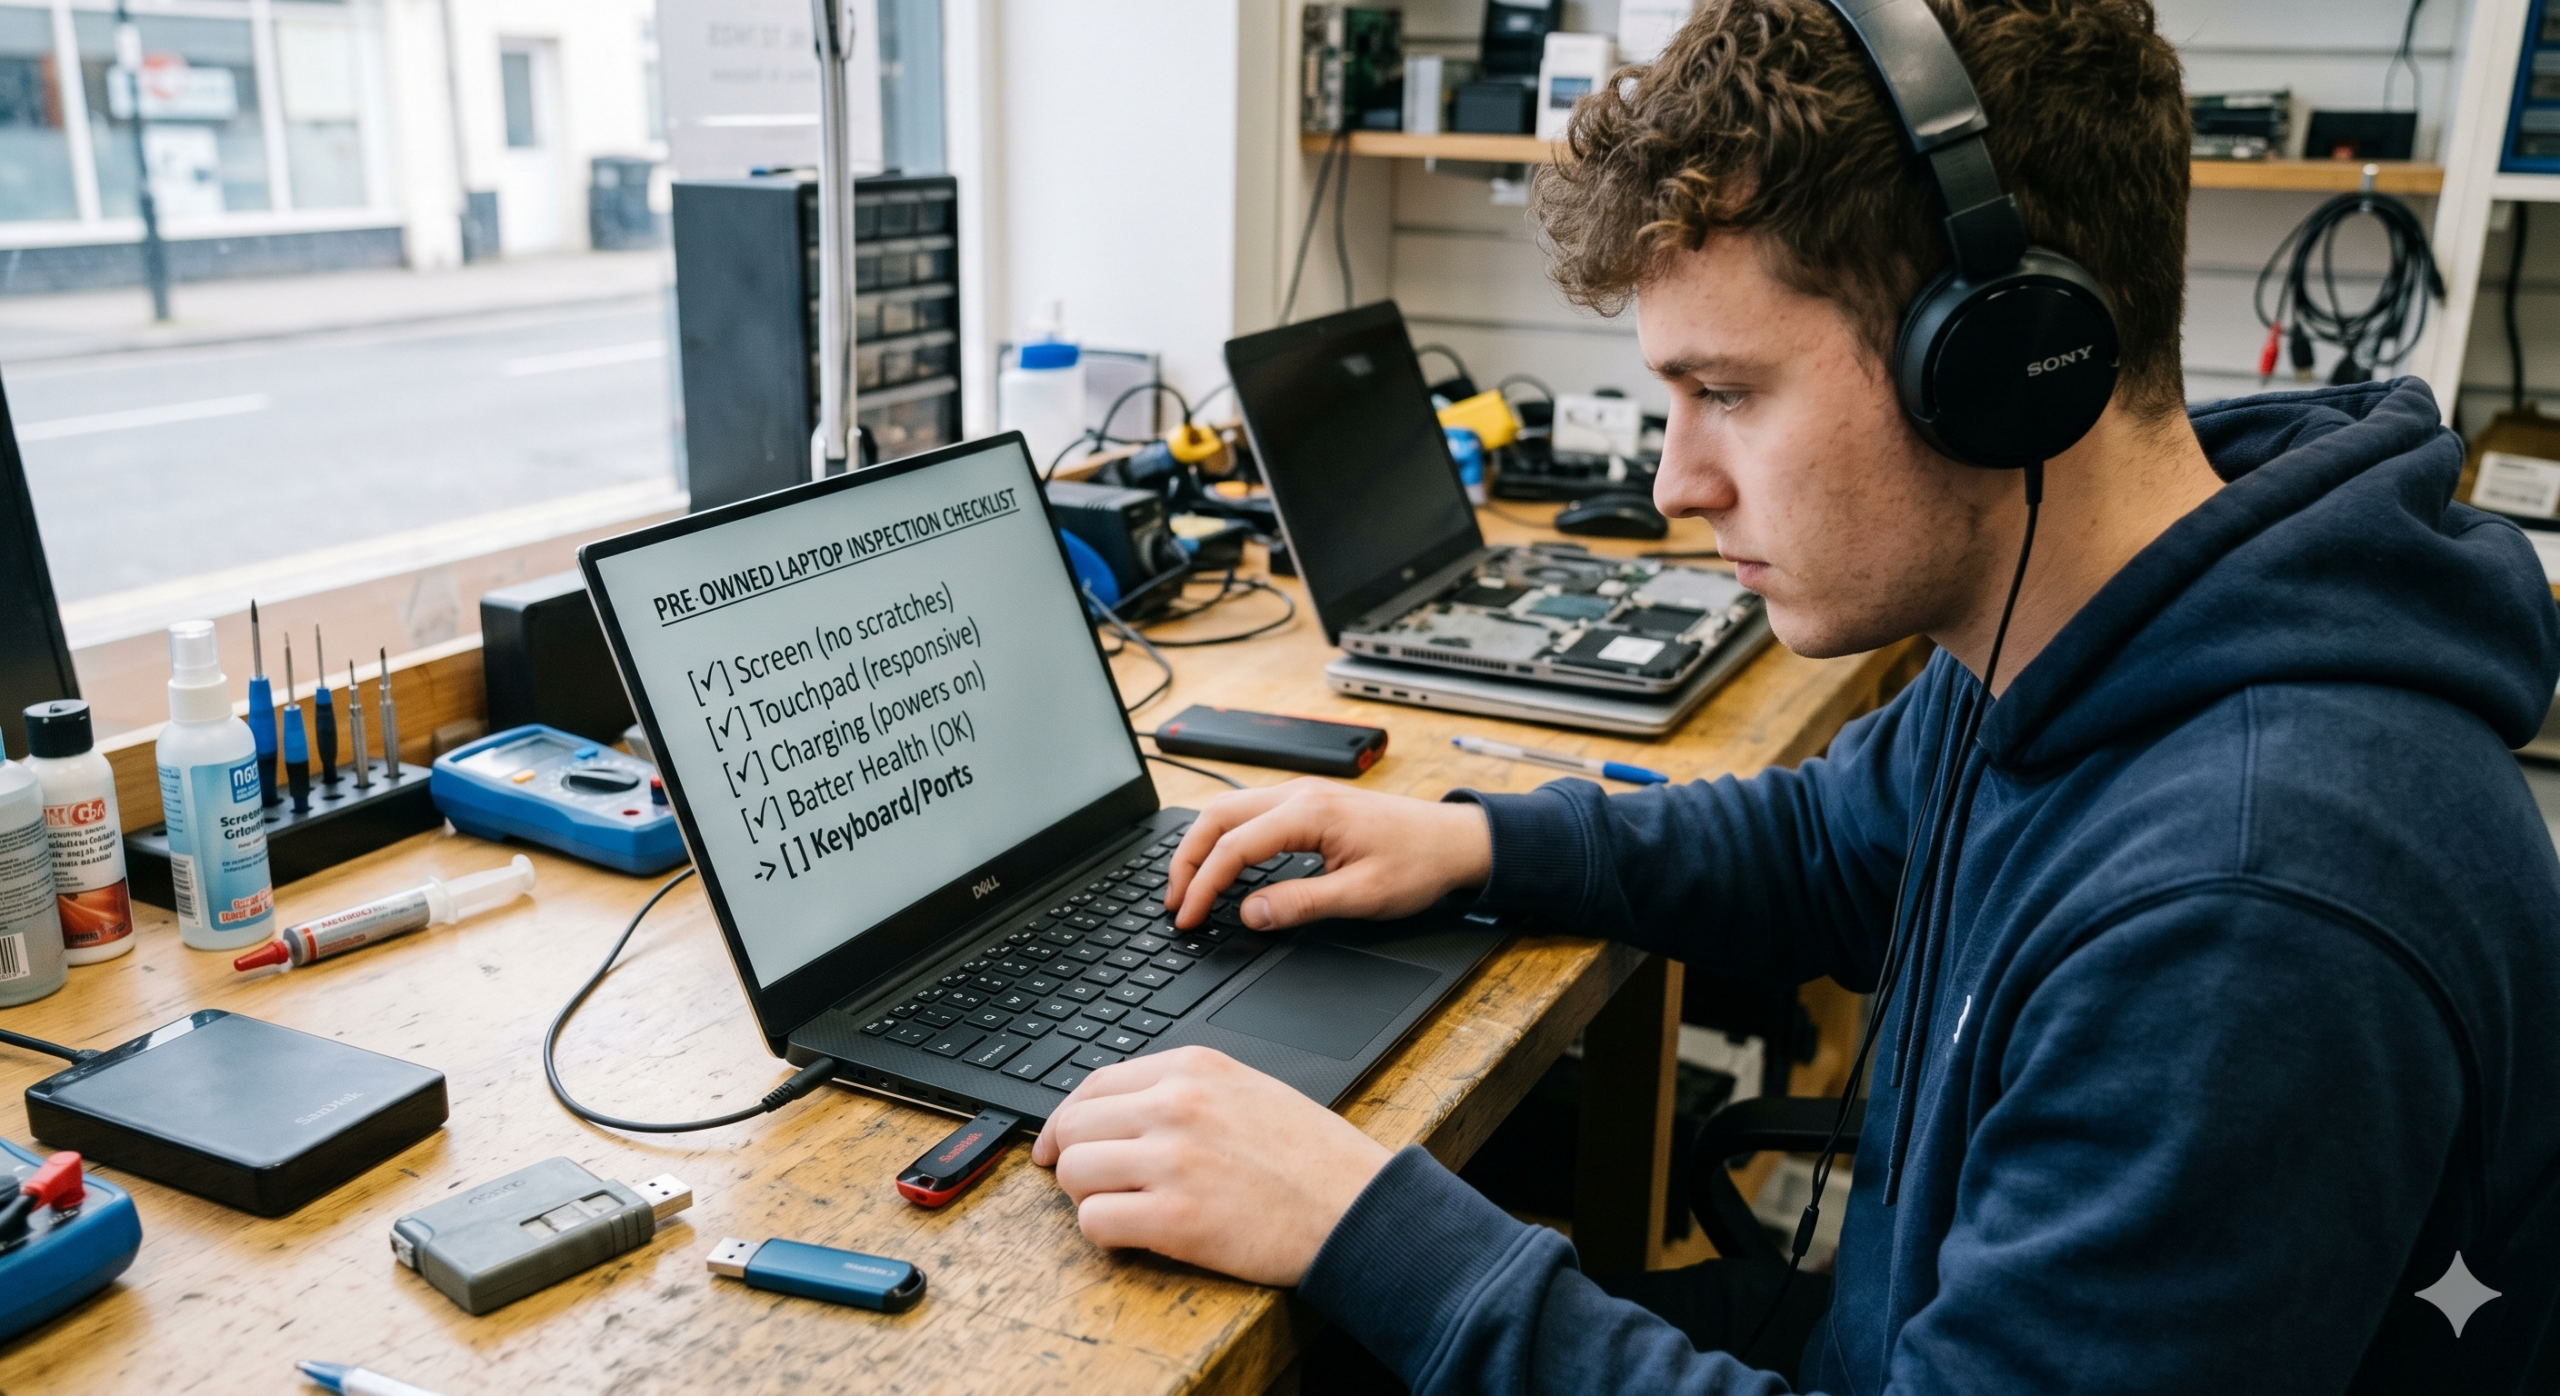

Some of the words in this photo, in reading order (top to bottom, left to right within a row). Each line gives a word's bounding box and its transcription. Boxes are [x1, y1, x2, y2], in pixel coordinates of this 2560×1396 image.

[2027, 345, 2093, 377] SONY
[776, 542, 843, 582] LAPTOP
[846, 512, 942, 559] INSPECTION
[942, 487, 1017, 528] CHECKLIST
[734, 640, 813, 684] Screen
[815, 626, 853, 660] (no
[856, 581, 954, 640] scratches)
[749, 662, 861, 728] Touchpad
[862, 616, 981, 690] (responsive)
[770, 716, 870, 772] Charging
[870, 682, 950, 736] (powers
[953, 659, 986, 695] on)
[786, 769, 855, 818] Batter
[858, 733, 929, 784] Health
[930, 710, 975, 757] (OK)
[809, 764, 974, 859] Keyboard/Ports
[972, 875, 1000, 900] DELL
